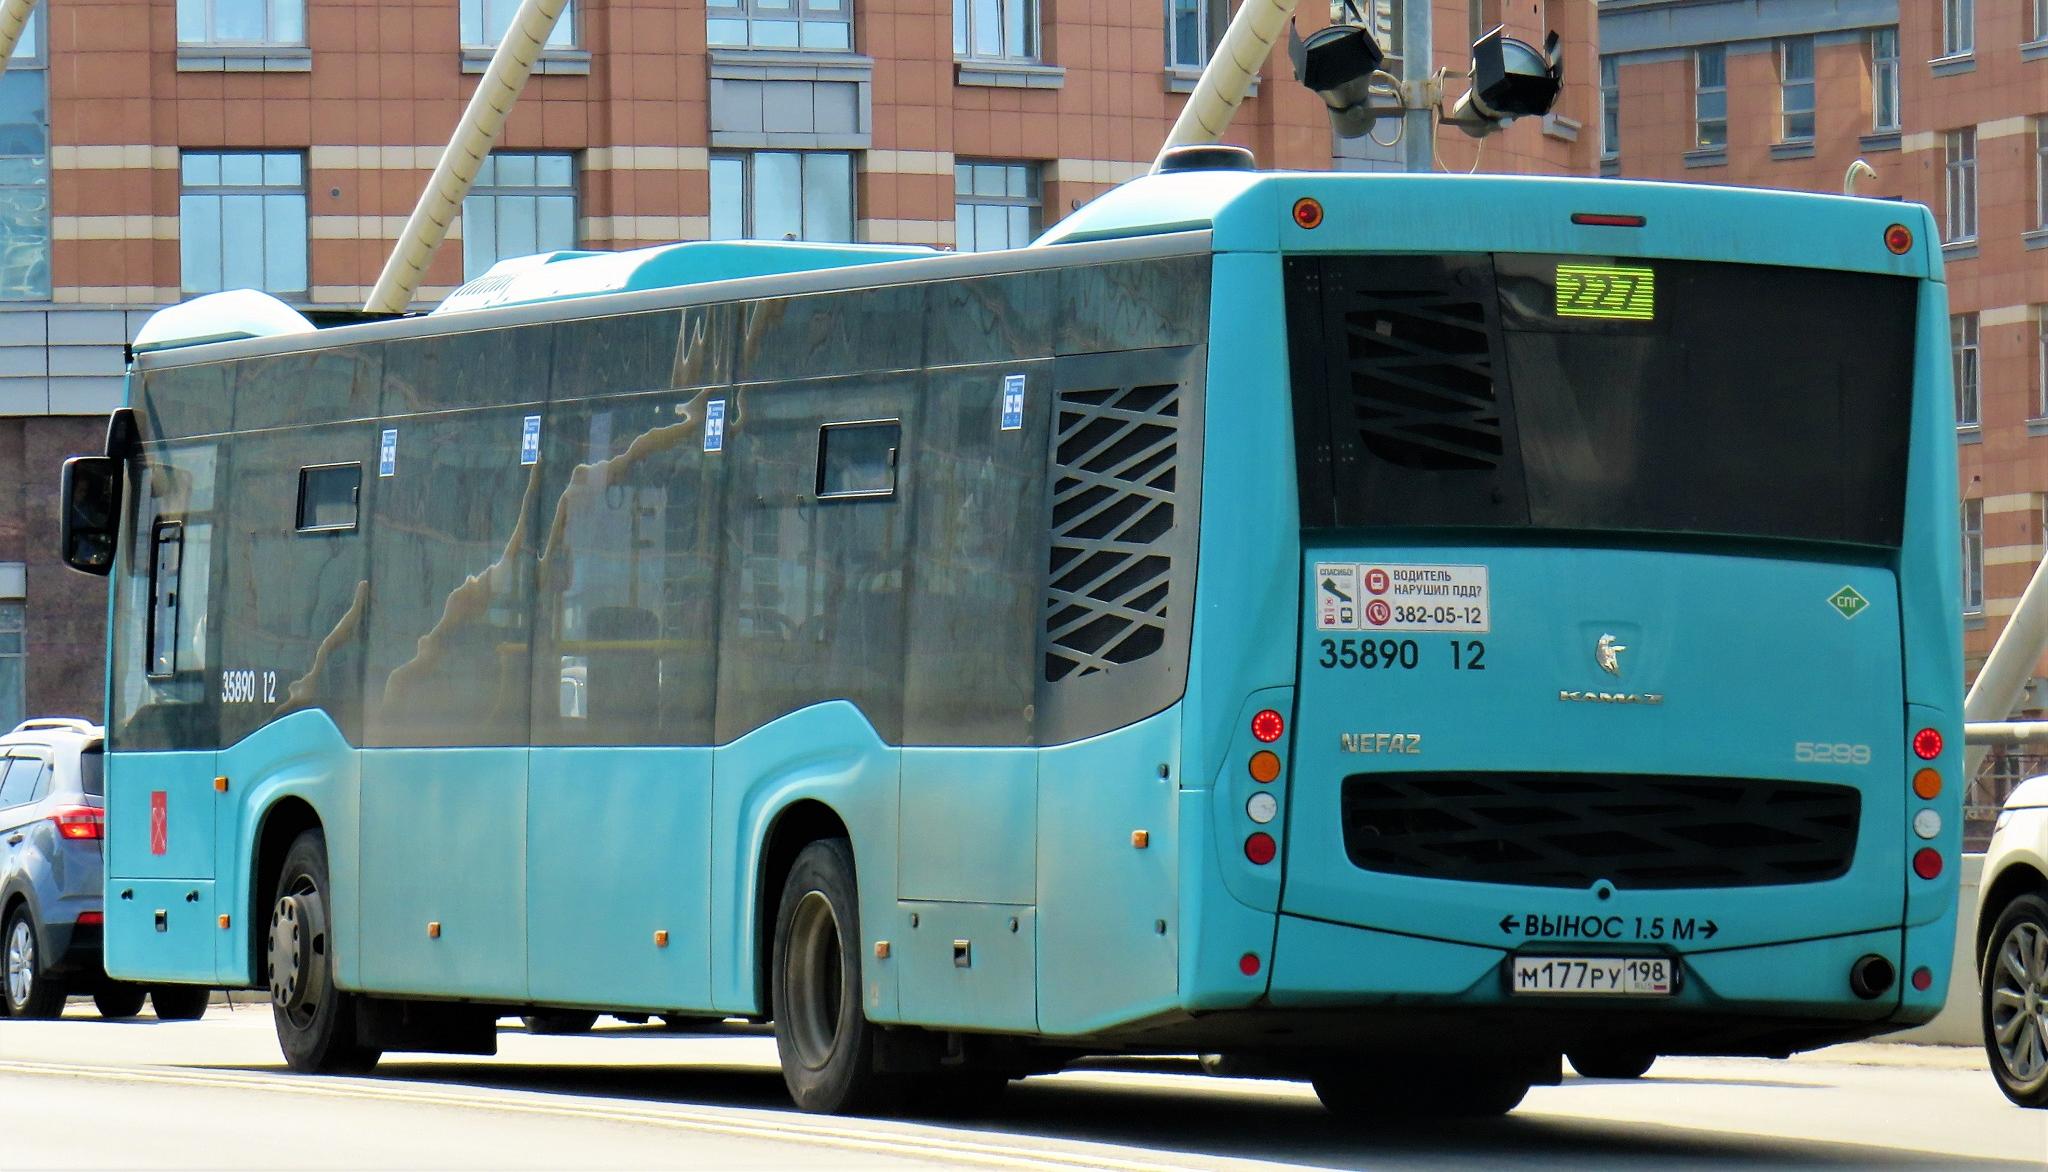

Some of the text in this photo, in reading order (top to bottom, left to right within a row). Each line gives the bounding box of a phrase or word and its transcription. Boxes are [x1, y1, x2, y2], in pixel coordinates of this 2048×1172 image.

[1567, 274, 1640, 310] 227
[1394, 570, 1452, 582] ВОДИТЕЛЬ
[1394, 584, 1482, 598] НАРУШИЛ ПДД?
[1837, 596, 1860, 608] СПГ
[1394, 606, 1482, 624] 382-05-12
[1319, 639, 1486, 670] 35890 12
[222, 670, 276, 703] 35890 12
[1340, 733, 1422, 754] NEFAZ
[1795, 742, 1871, 765] 5299
[1524, 914, 1624, 939] ВЫНОС
[1635, 917, 1665, 939] 1.5
[1628, 961, 1666, 982] 198
